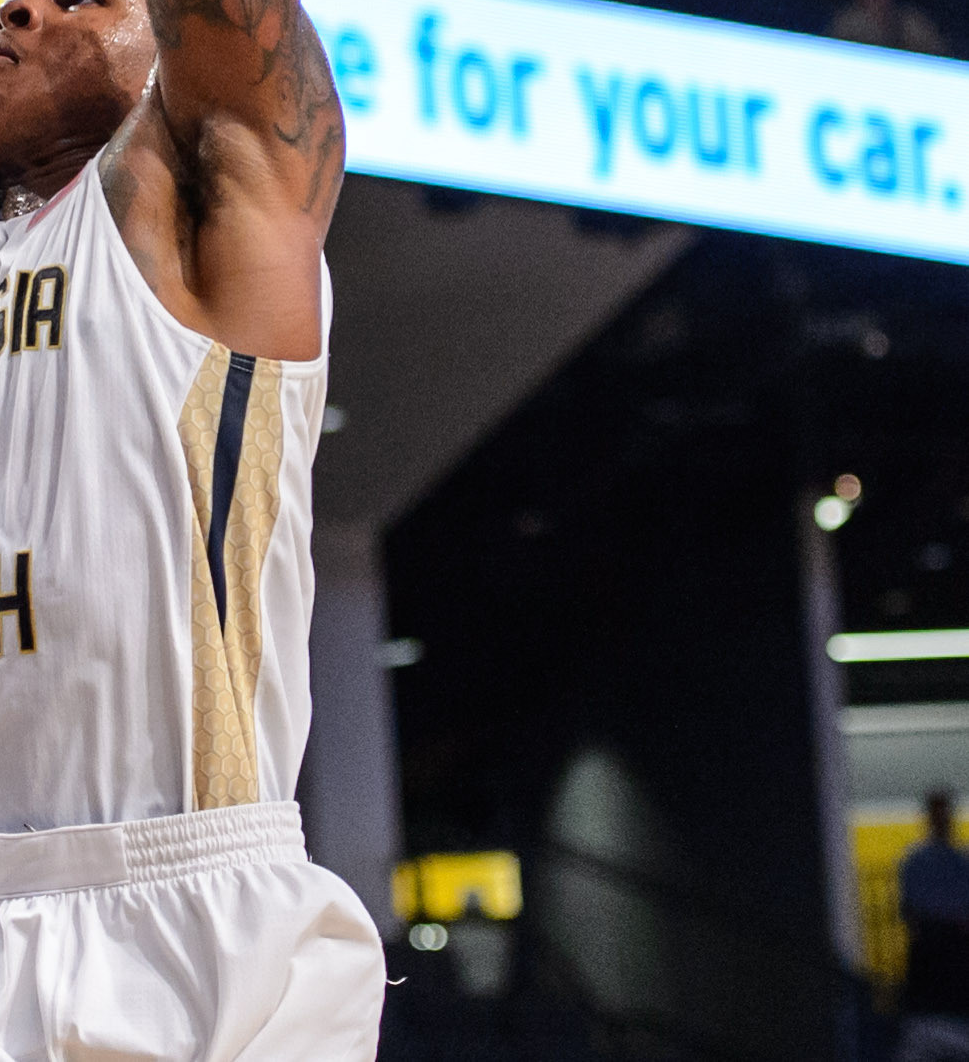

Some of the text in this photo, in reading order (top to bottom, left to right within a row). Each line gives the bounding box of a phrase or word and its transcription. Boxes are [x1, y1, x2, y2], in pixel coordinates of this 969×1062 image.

[408, 8, 541, 138] for
[572, 62, 775, 179] your
[804, 100, 964, 208] car.
